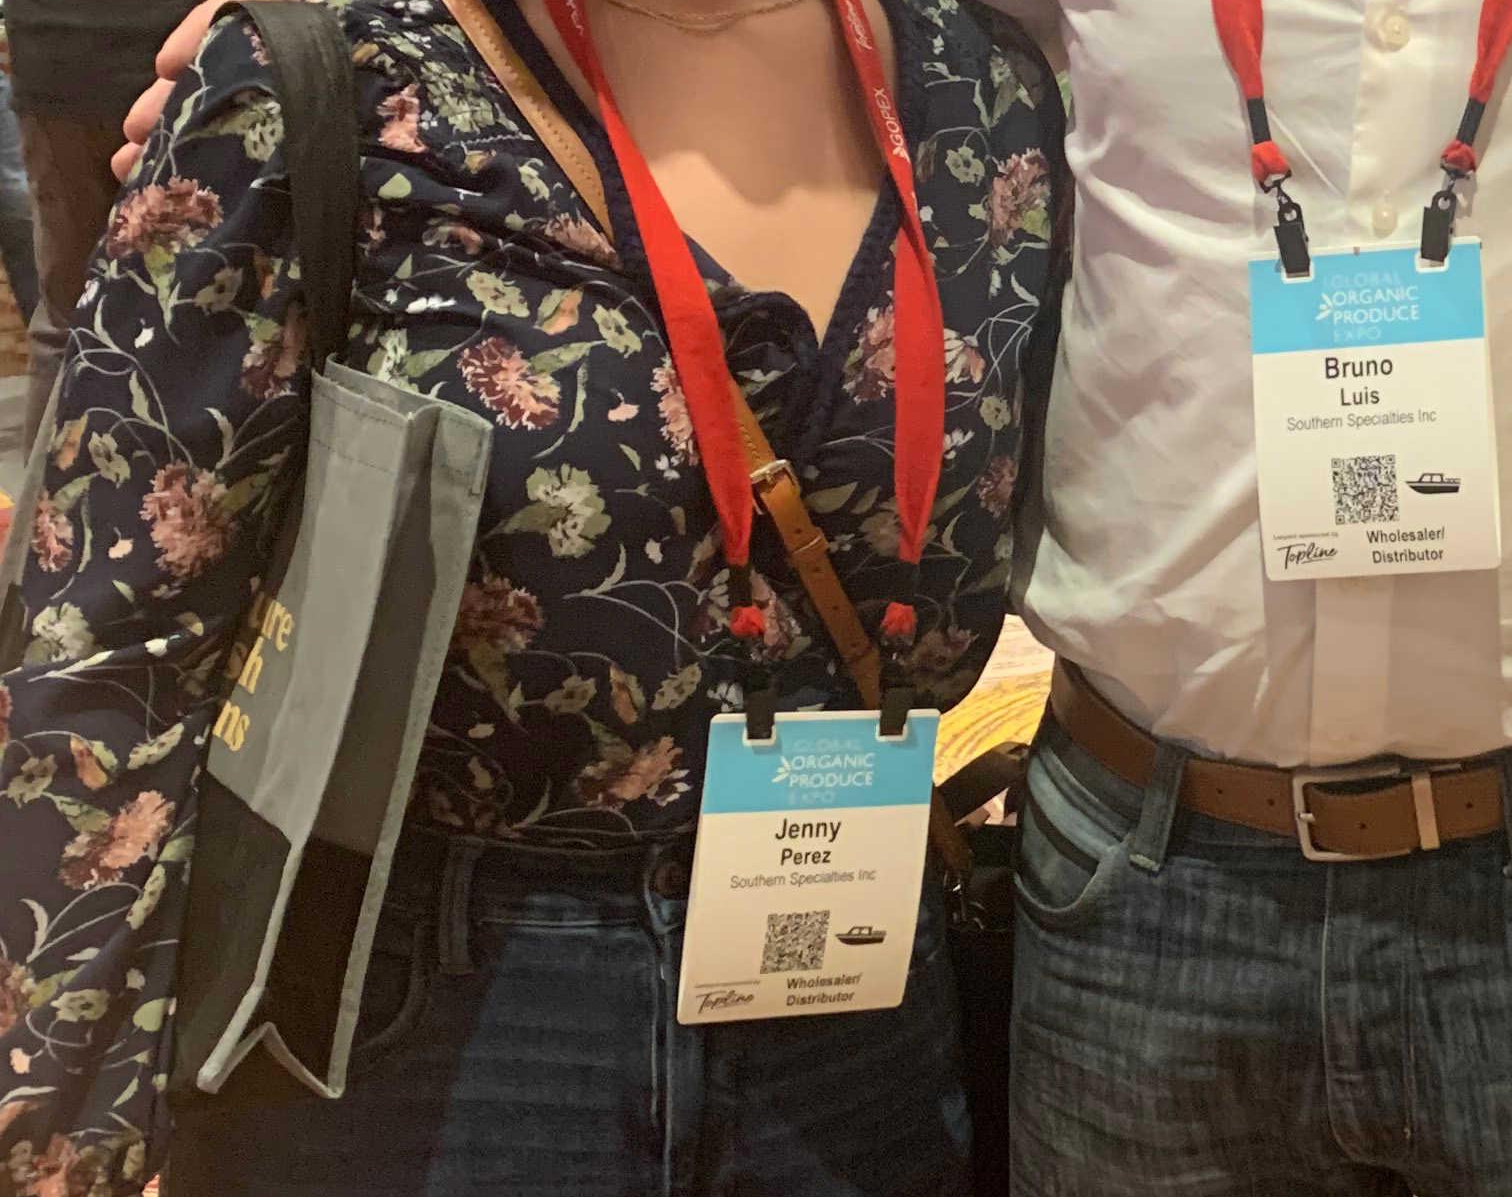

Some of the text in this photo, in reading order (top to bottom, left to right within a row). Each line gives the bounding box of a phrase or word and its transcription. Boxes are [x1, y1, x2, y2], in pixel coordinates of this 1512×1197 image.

[873, 88, 904, 148] GOPEX
[1331, 271, 1400, 289] GLOBAL
[1332, 286, 1419, 306] ORGANIC
[1333, 305, 1420, 325] PRODUCE
[1333, 326, 1381, 343] EXPO
[1325, 357, 1393, 379] Bruno
[1340, 386, 1380, 406] Luis
[1287, 409, 1437, 431] Southern Specialties Inc
[1366, 526, 1445, 543] Wholesaler/
[1277, 542, 1338, 570] Topline
[1372, 549, 1443, 564] Distributor
[791, 752, 875, 770] ORGANIC
[788, 771, 874, 788] PRODUCE
[775, 818, 842, 843] Jenny
[780, 848, 831, 866] Perez
[730, 869, 876, 889] Southern Specialties Inc
[786, 972, 863, 989] Wholesaler/
[695, 990, 754, 1014] Topline
[786, 991, 855, 1006] Distributor
